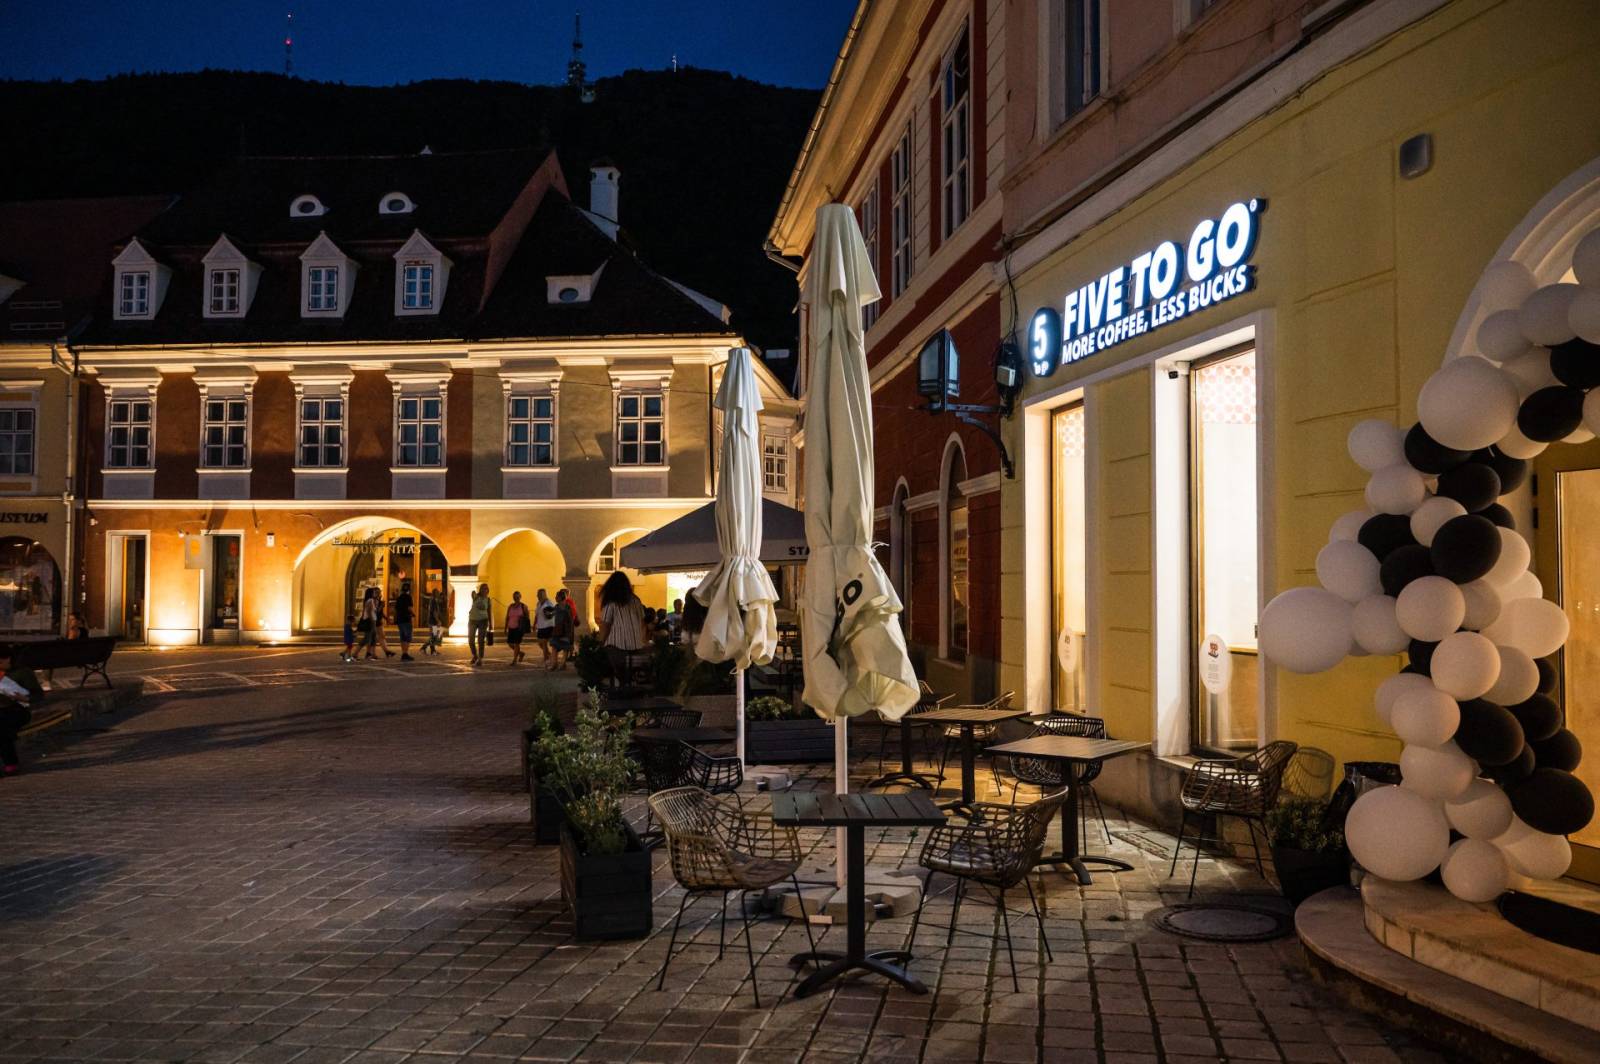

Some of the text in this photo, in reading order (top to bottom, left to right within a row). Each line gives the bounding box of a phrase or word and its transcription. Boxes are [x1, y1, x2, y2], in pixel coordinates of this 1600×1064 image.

[1062, 264, 1248, 365] MORE COFFEE, LESS BUCKS
[1063, 202, 1251, 341] FIVE TO GO
[1033, 313, 1048, 360] 5
